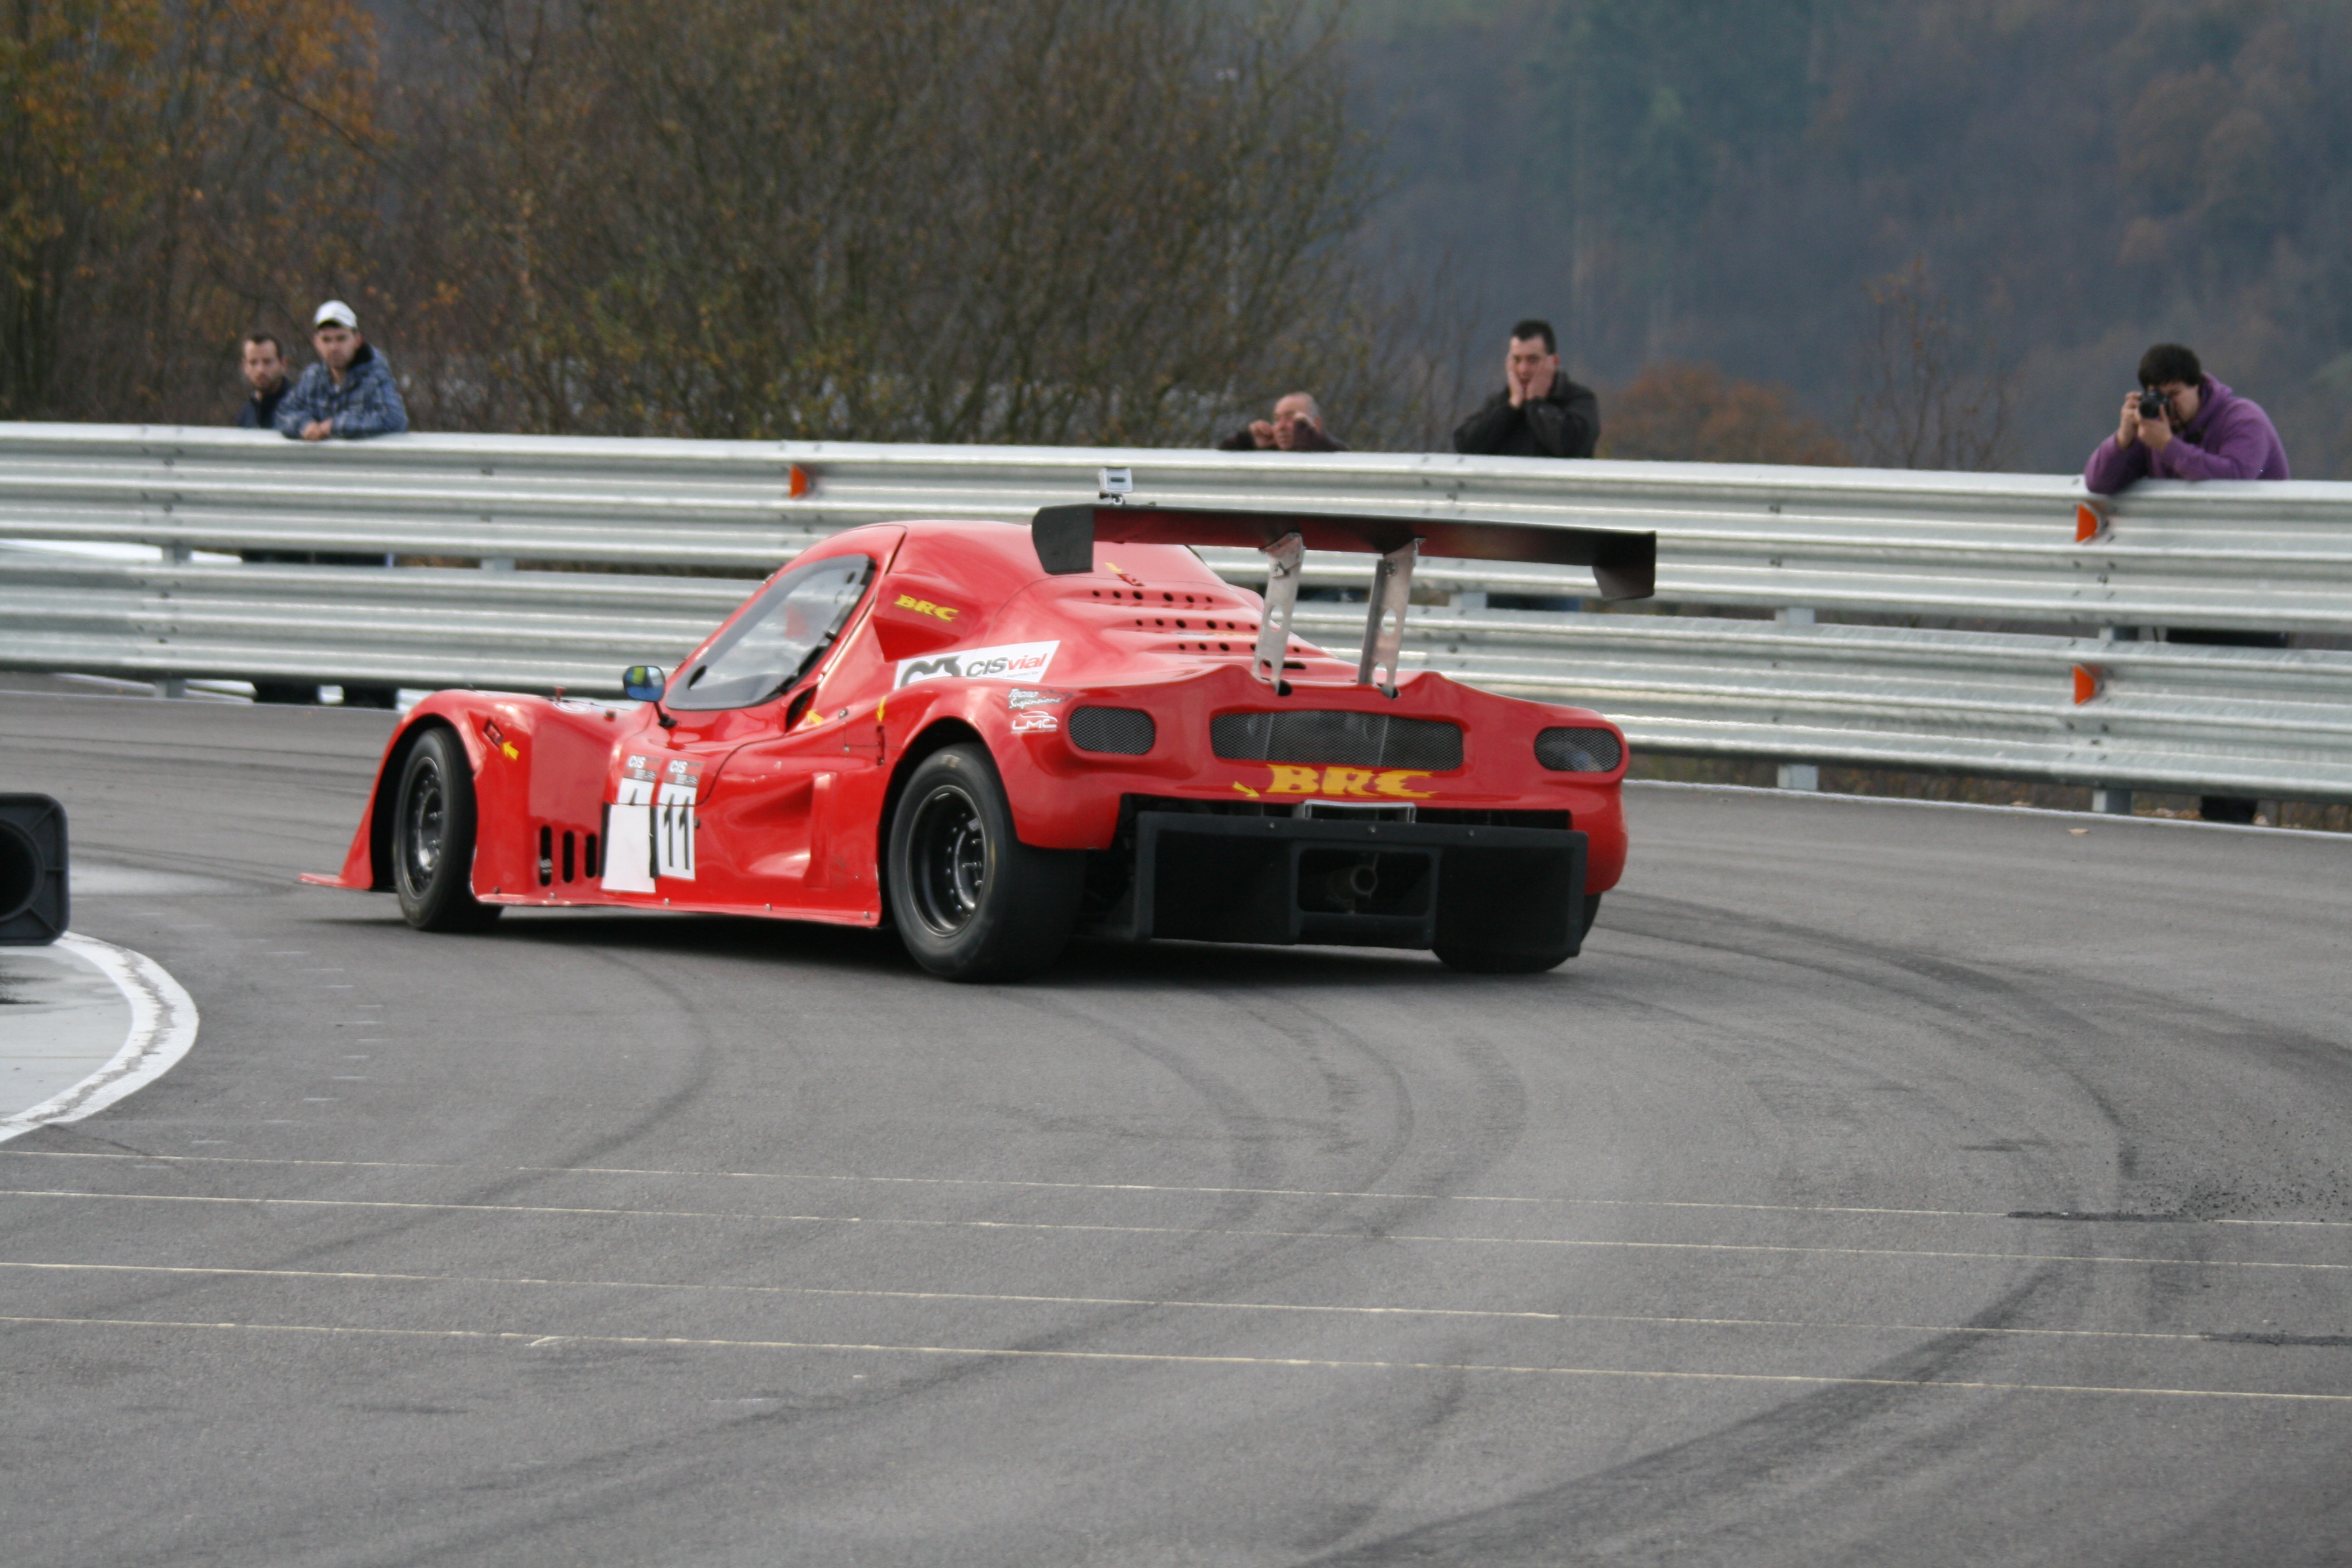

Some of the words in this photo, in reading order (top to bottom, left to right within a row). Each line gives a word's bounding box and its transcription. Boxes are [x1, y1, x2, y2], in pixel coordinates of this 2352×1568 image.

[894, 593, 960, 622] BRC
[1008, 688, 1039, 698] Tecno
[1012, 718, 1057, 730] LMC
[1266, 763, 1441, 799] BRC
[664, 792, 691, 871] 11
